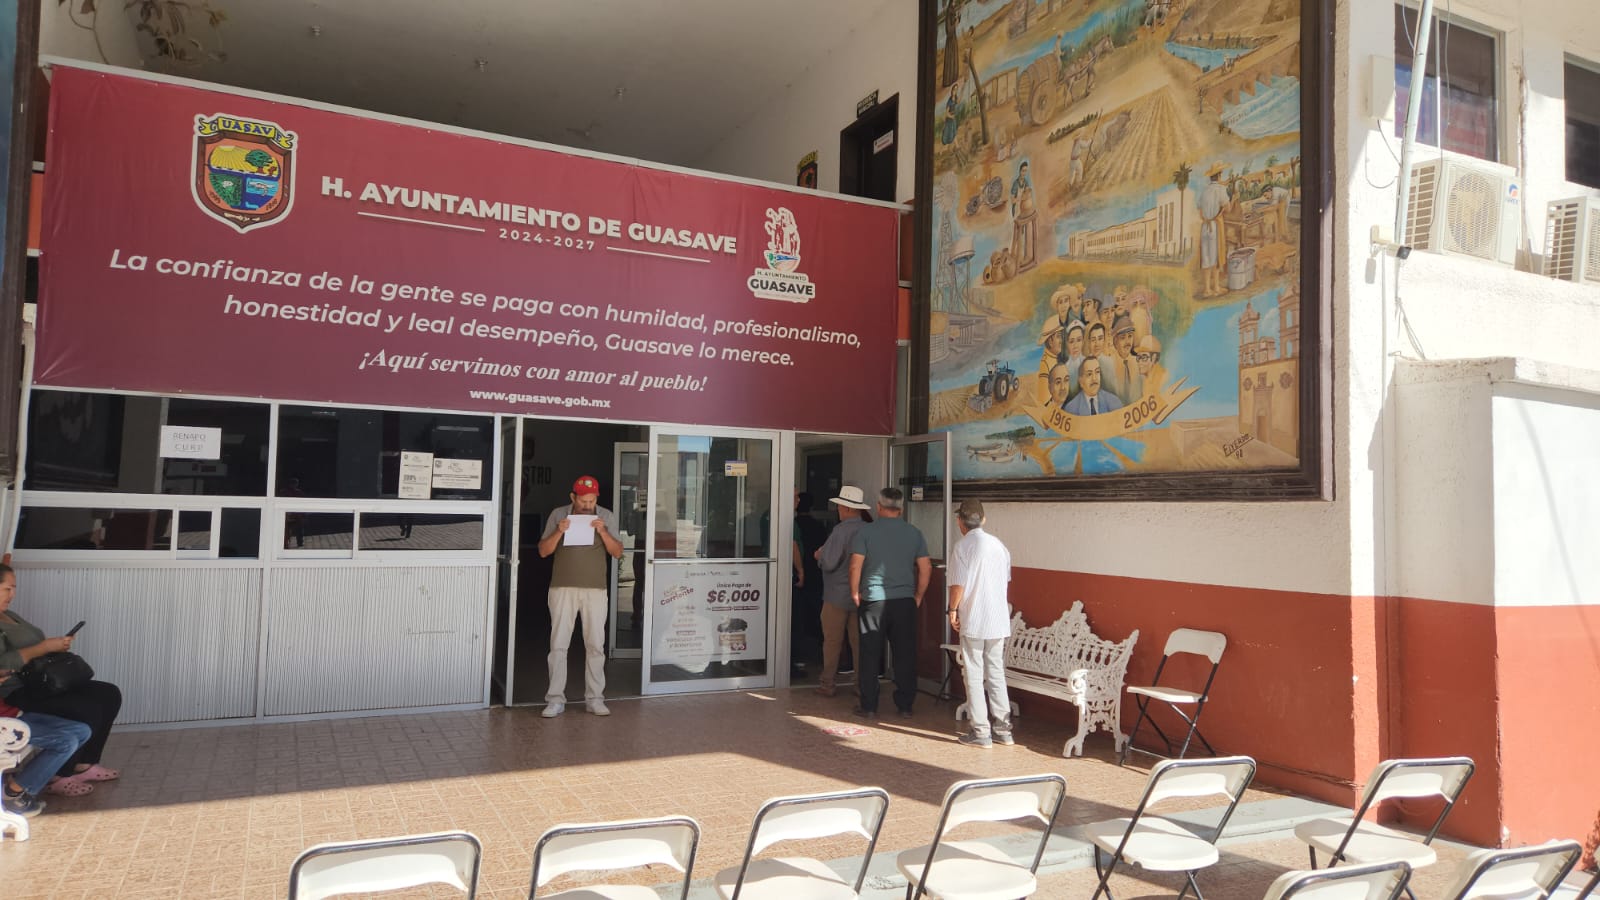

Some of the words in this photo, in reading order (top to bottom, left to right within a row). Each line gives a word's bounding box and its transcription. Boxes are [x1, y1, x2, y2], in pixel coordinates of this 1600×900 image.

[209, 118, 283, 143] GUASAVE
[321, 175, 352, 199] H.
[359, 182, 582, 232] AYUNTAMIENTO
[588, 215, 622, 238] DE
[627, 222, 737, 254] GUASAVE
[499, 228, 595, 251] 2024-2027
[110, 249, 148, 271] La
[156, 258, 302, 287] confianza
[308, 271, 343, 291] de
[349, 274, 375, 295] la
[380, 283, 455, 304] gente
[459, 291, 487, 307] se
[492, 295, 554, 317] paga
[559, 303, 598, 320] con
[604, 303, 708, 334] humildad,
[712, 319, 861, 348] profesionalismo,
[749, 278, 814, 296] GUASAVE
[223, 294, 382, 328] honestidad
[383, 314, 404, 333] y
[408, 312, 455, 335] leal
[459, 318, 599, 352] desempeño,
[605, 333, 695, 357] Guasave
[698, 341, 717, 359] lo
[721, 347, 795, 366] merece.
[357, 348, 429, 373] ¡Aquí
[428, 358, 522, 378] servimos
[525, 366, 561, 381] con
[564, 369, 617, 385] amor
[618, 370, 639, 387] al
[638, 373, 709, 392] pueblo!
[469, 390, 611, 409] www.guasave.gob.mx
[1050, 409, 1072, 433] 1916
[1124, 394, 1157, 430] 2006
[660, 587, 694, 605] Corriente
[706, 589, 760, 604] $6,000
